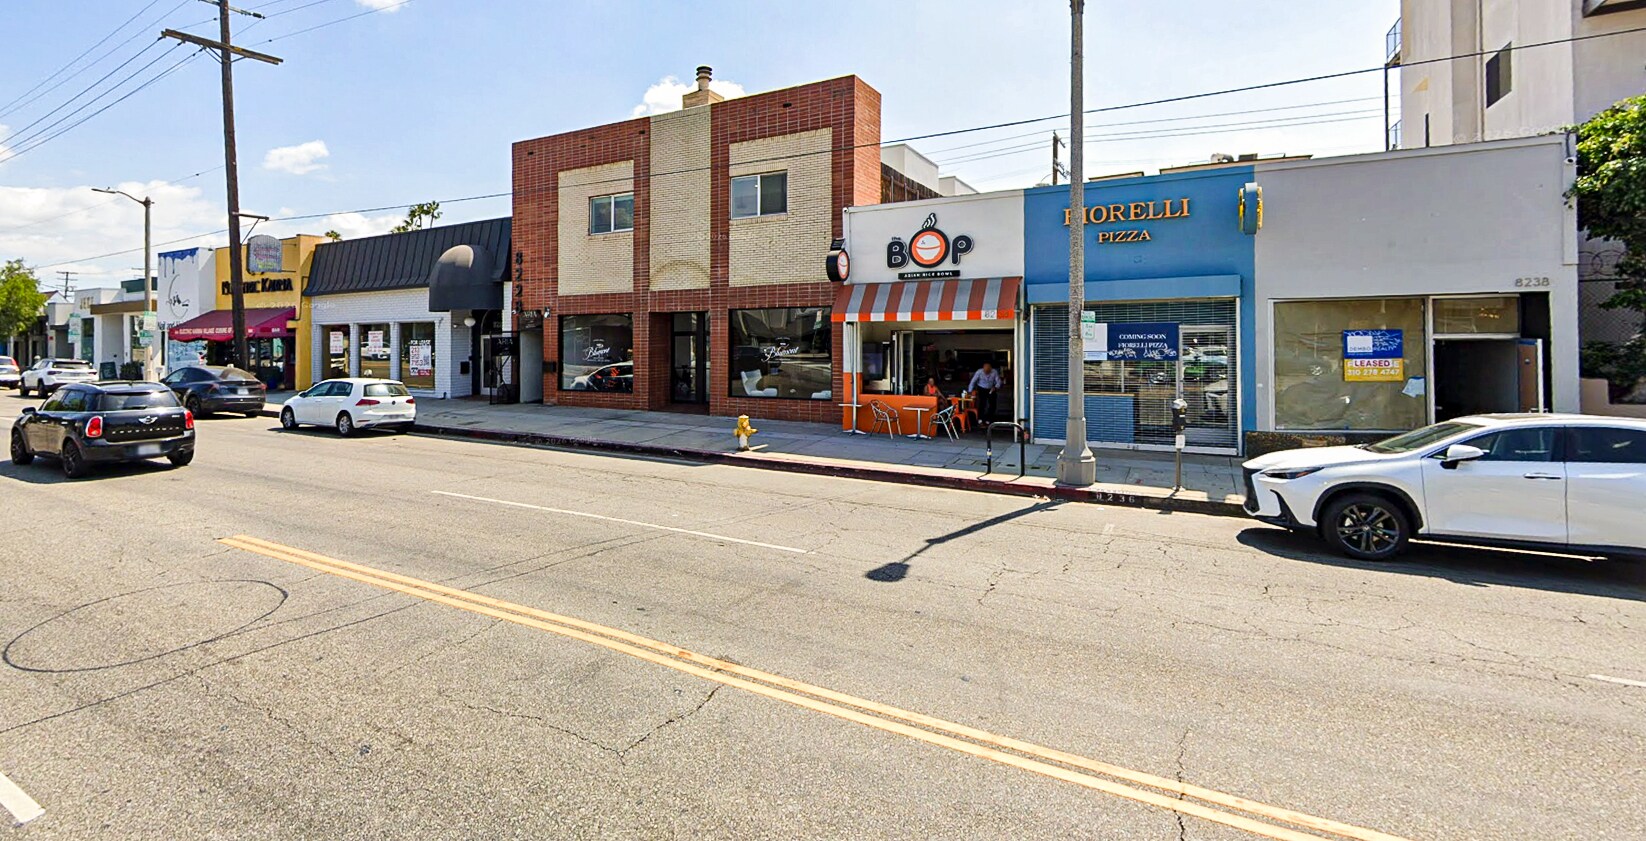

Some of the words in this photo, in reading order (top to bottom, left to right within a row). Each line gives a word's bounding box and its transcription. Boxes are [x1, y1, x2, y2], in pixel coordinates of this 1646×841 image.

[1098, 230, 1151, 243] PIZZA
[887, 228, 975, 269] BOP
[1515, 277, 1549, 287] 8238
